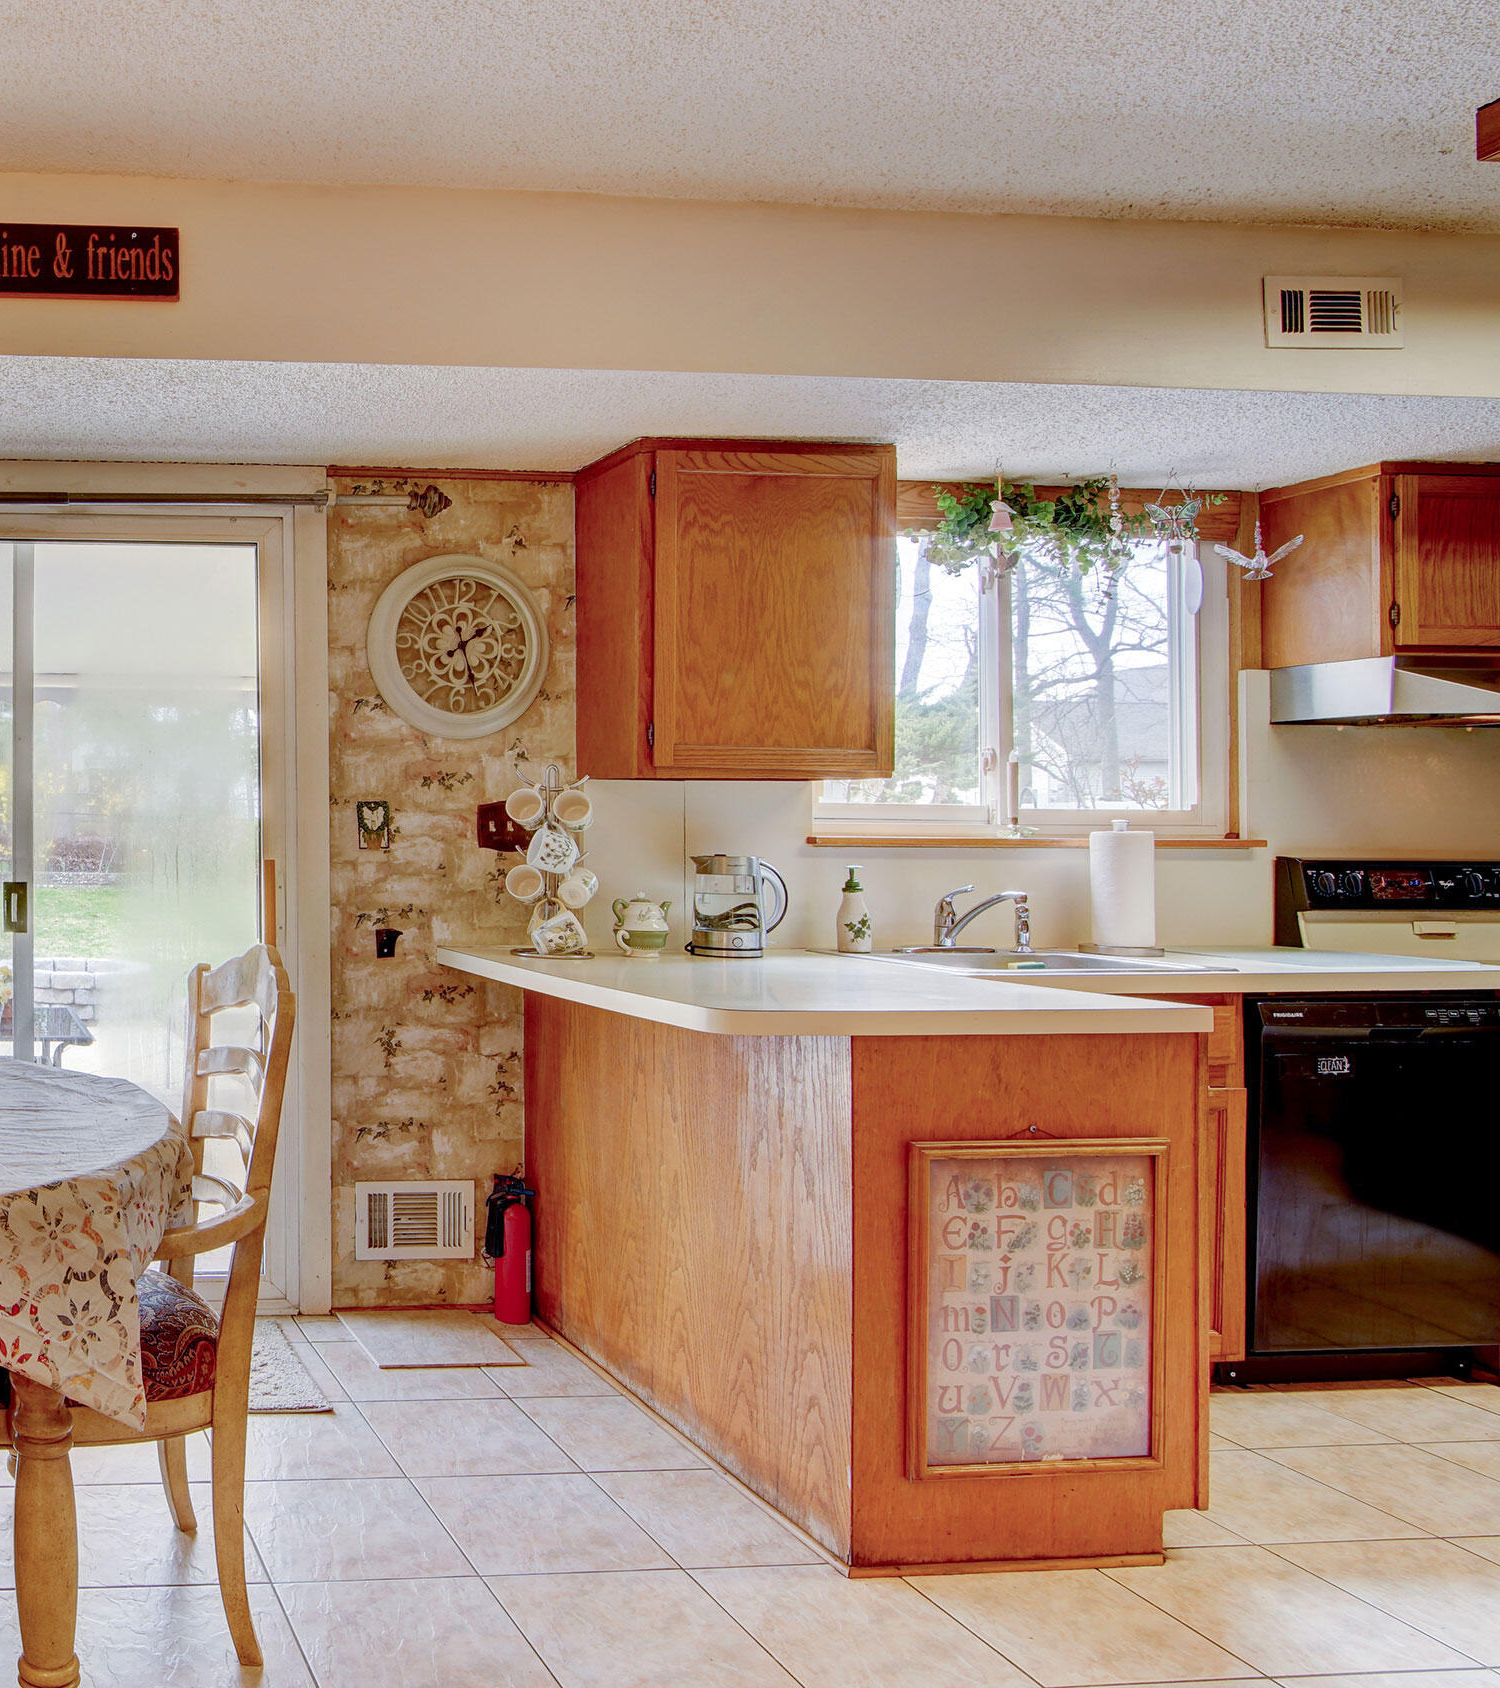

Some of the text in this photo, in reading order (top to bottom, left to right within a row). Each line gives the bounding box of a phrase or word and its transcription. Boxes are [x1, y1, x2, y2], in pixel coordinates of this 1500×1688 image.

[53, 231, 74, 278] &
[87, 233, 174, 281] friends
[453, 579, 476, 607] 12
[501, 643, 526, 660] 3
[402, 660, 426, 679] 8
[450, 687, 466, 713] 6
[938, 1175, 966, 1212] A
[995, 1173, 1017, 1208] b
[1099, 1171, 1119, 1206] d
[996, 1215, 1026, 1248] F
[1046, 1215, 1070, 1251] g
[1095, 1211, 1125, 1250] H
[993, 1254, 1012, 1294] j
[1093, 1253, 1119, 1290] L
[940, 1305, 970, 1333] m
[995, 1299, 1017, 1328] N
[993, 1343, 1010, 1371] r
